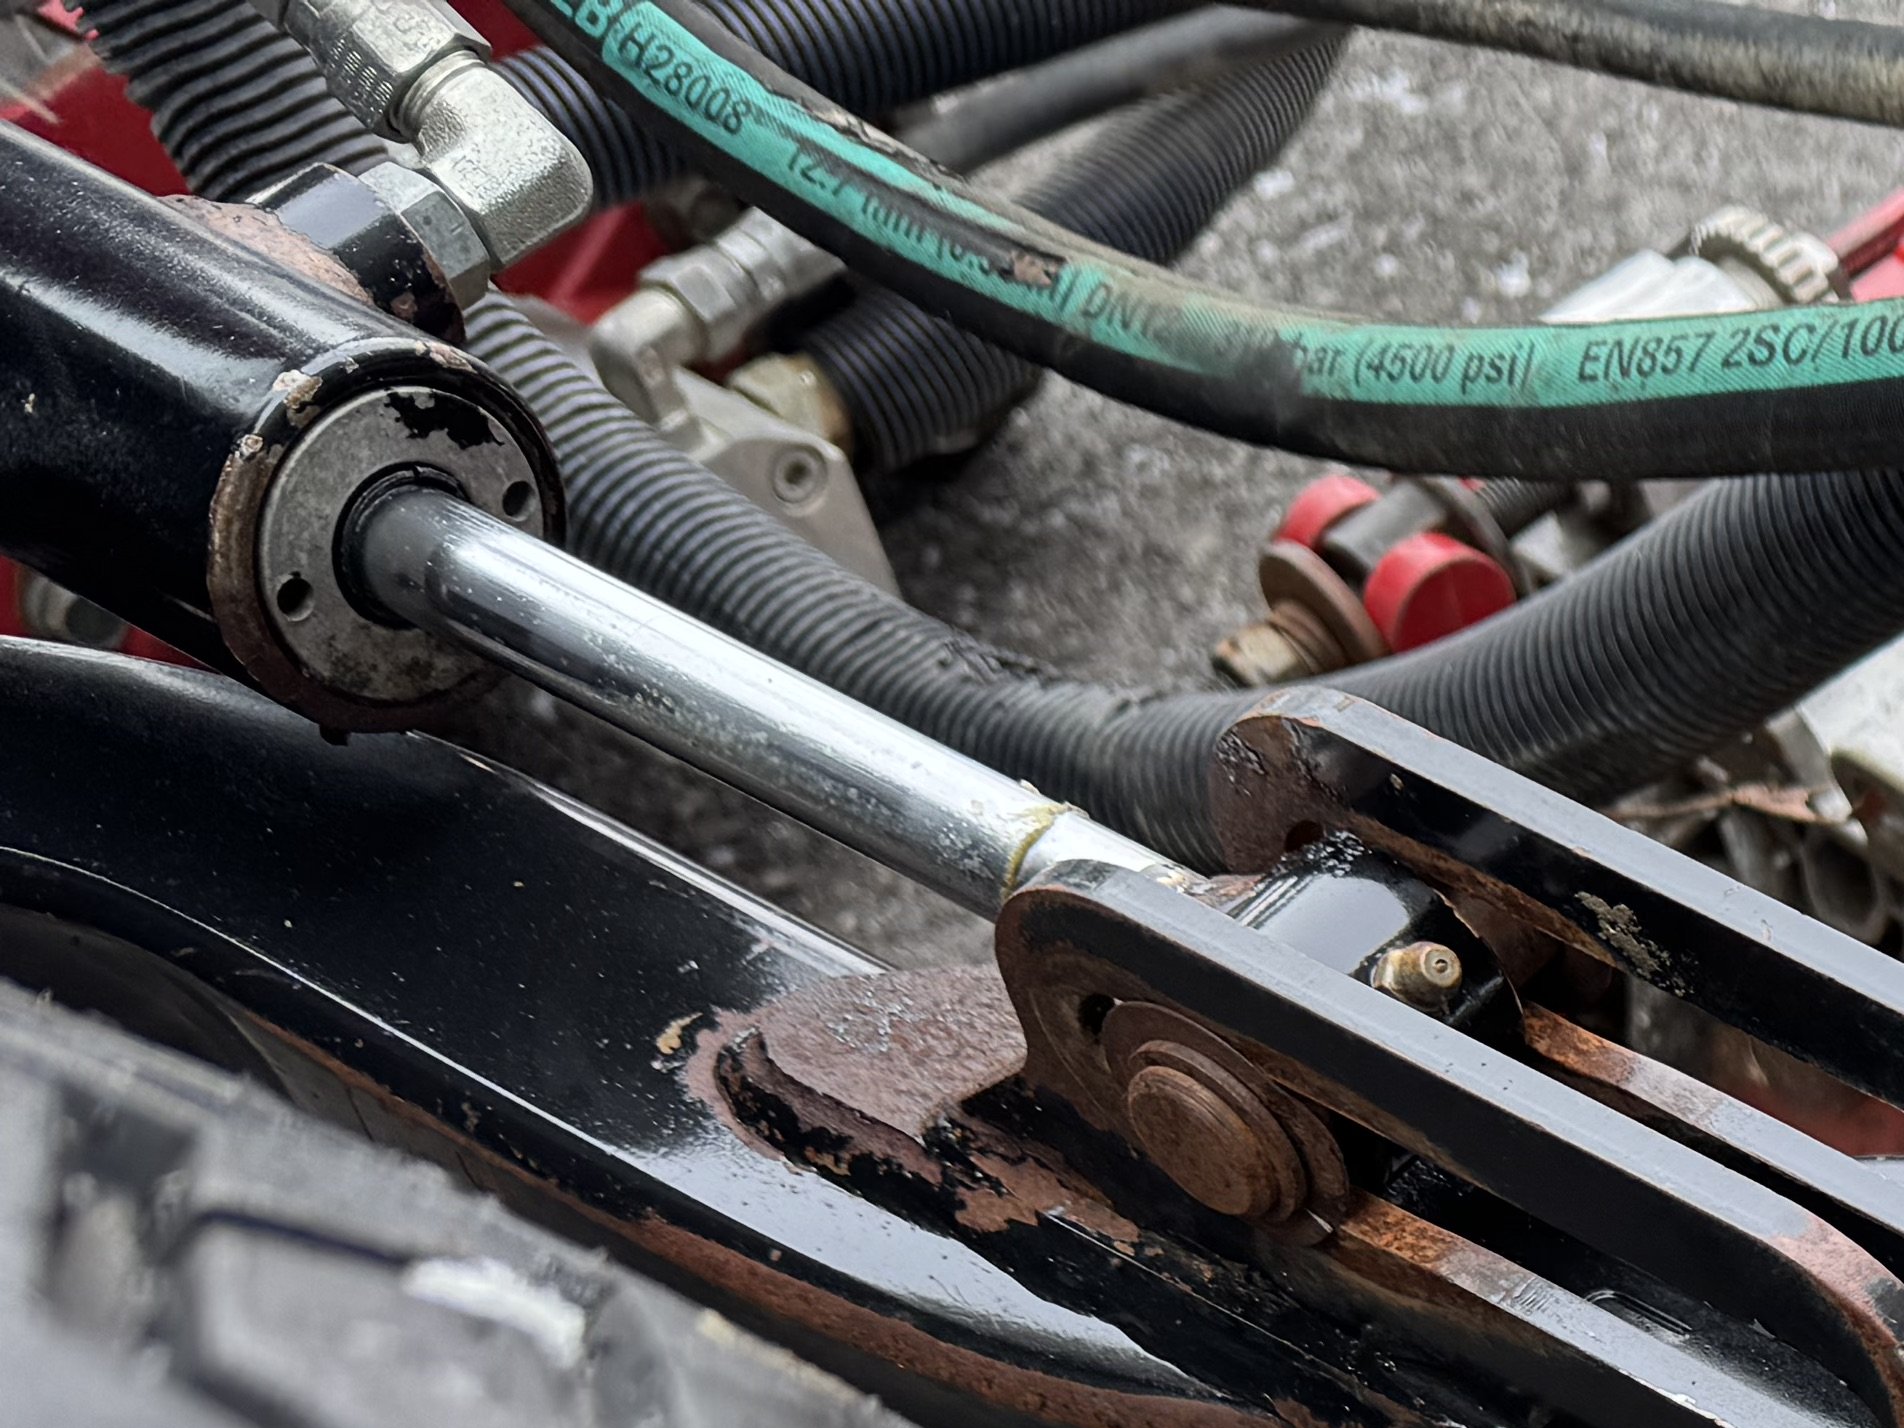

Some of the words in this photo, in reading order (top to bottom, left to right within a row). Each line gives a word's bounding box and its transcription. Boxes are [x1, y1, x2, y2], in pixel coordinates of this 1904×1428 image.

[617, 21, 752, 136] H28008
[1353, 338, 1454, 388] (4500
[1459, 338, 1536, 396] psi)
[1577, 330, 1711, 384] EN857
